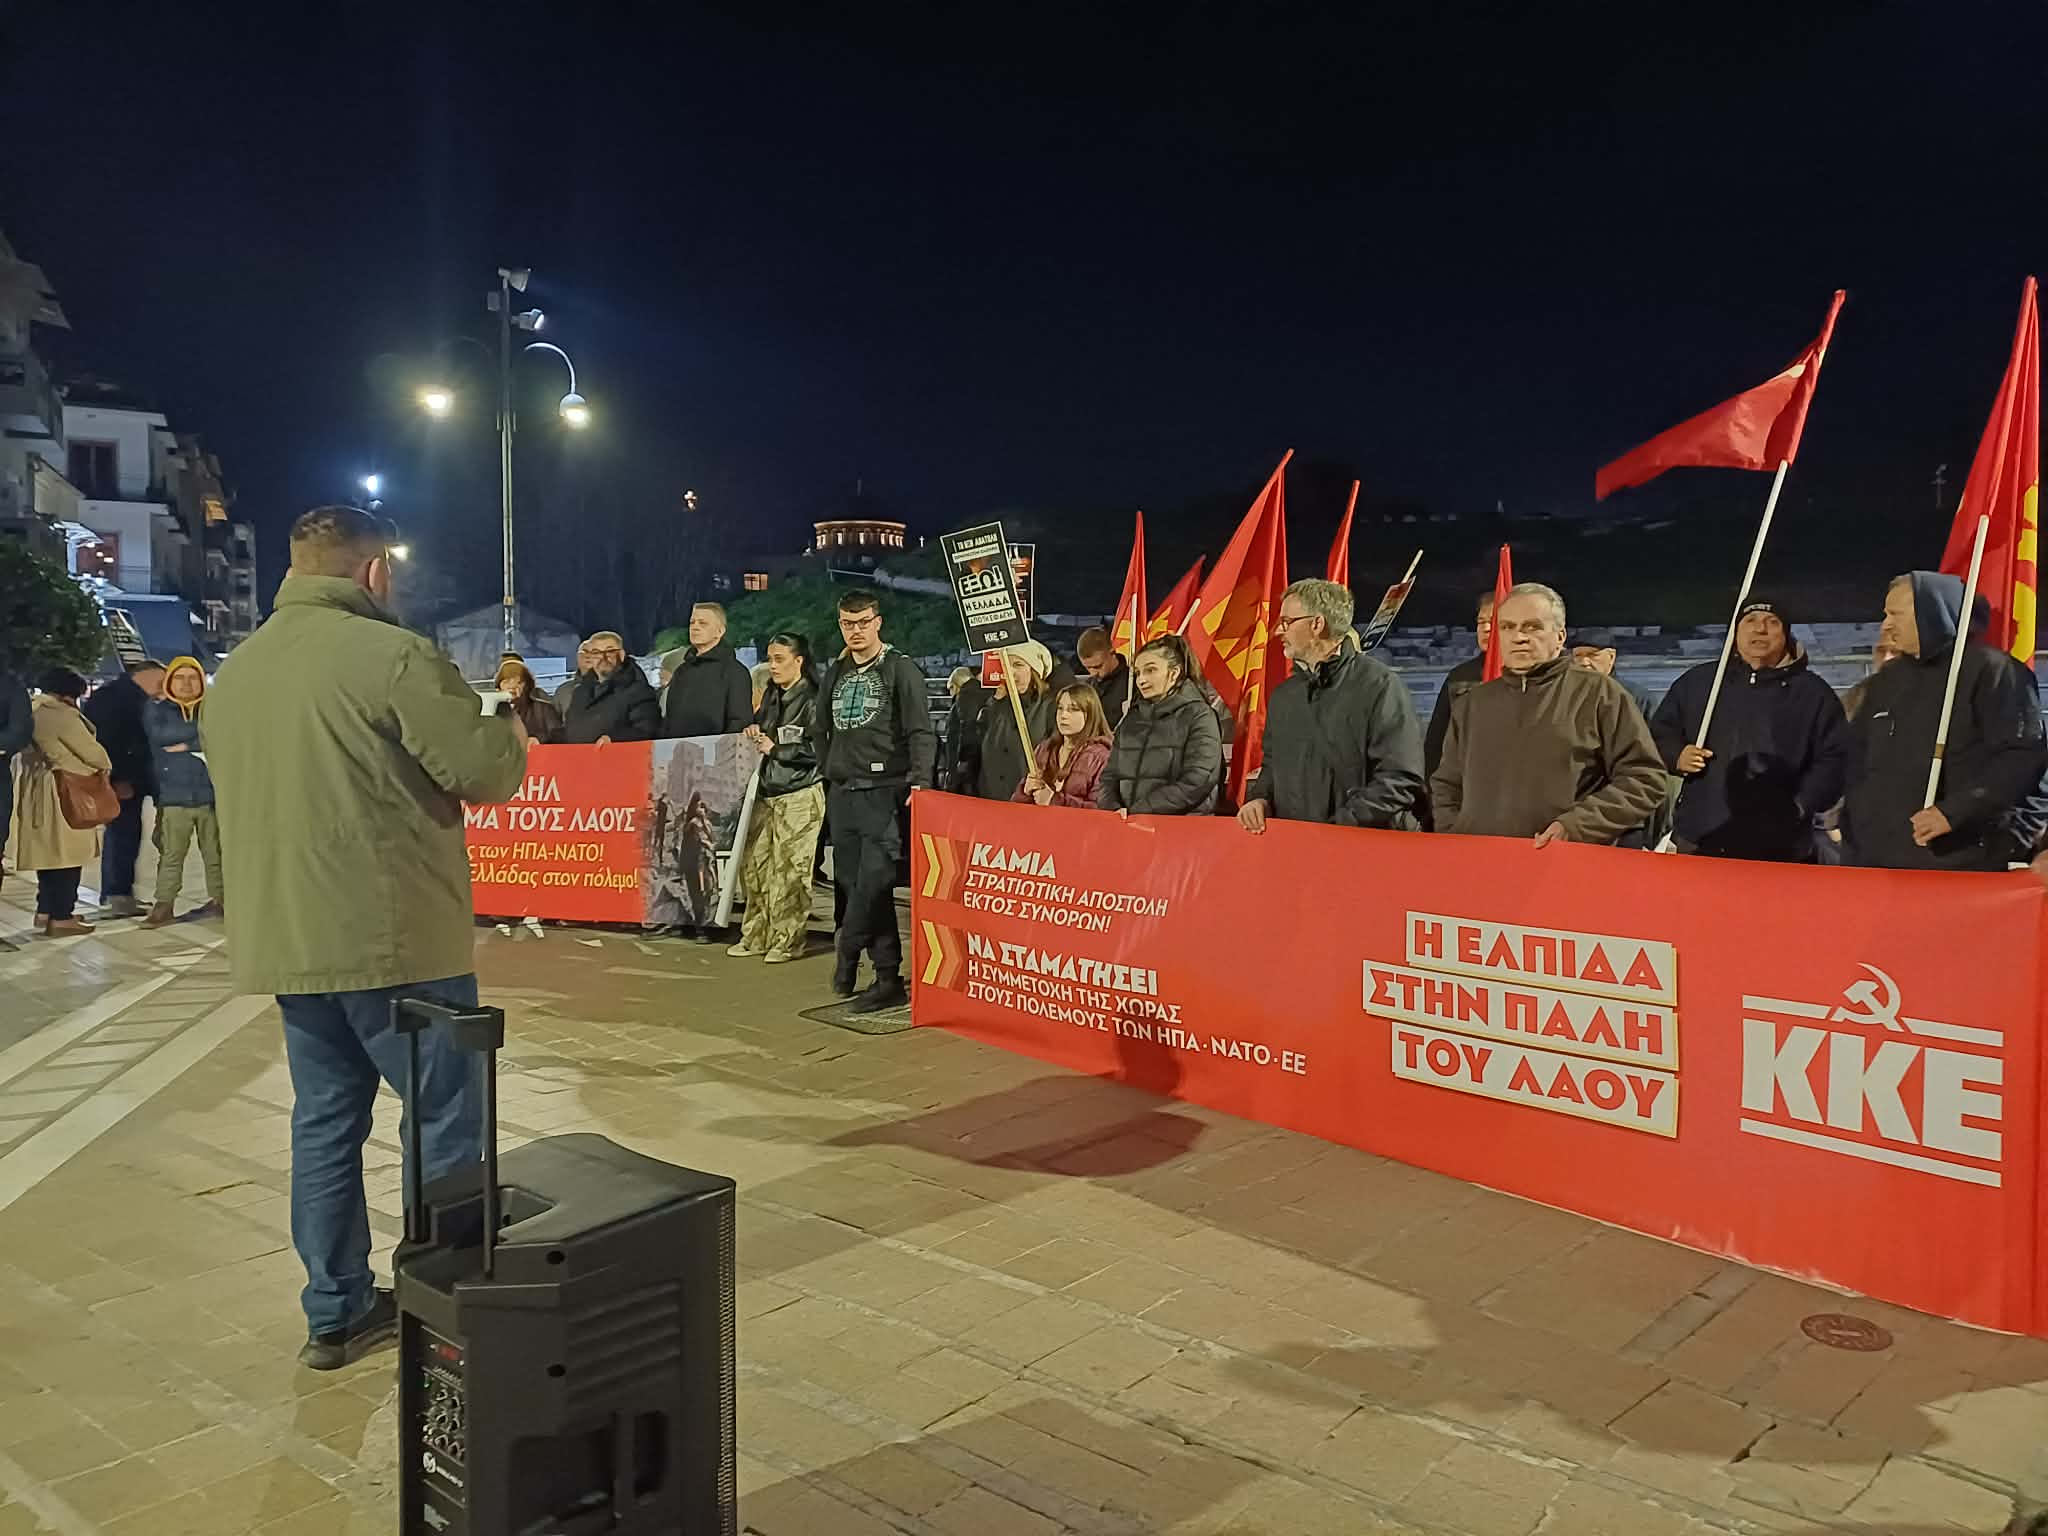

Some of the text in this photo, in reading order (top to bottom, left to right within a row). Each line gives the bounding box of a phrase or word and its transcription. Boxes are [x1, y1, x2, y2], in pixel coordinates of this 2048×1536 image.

[960, 565, 1004, 596] ΕΞΩ!
[973, 594, 1009, 611] ΕΛΛΑΔΑ
[510, 775, 561, 802] ΑΗΛ
[463, 805, 636, 832] ΜΑ ΤΟΥΣ ΛΑΟΥΣ
[479, 845, 510, 859] των
[971, 843, 1057, 879] ΚΑΜΙΑ
[542, 871, 581, 887] στον
[583, 866, 639, 894] πόλεμο!
[965, 870, 1169, 917] ΣΤΡΑΤΙΩΤΙΚΗ ΑΠΟΣΤΟΛΗ
[963, 891, 1112, 934] ΕΚΤΟΣ ΣΥΝΟΡΩΝ!
[967, 931, 1158, 996] ΝΑ ΣΤΑΜΑΤΗΣΕΙ
[1413, 919, 1664, 992] Η ΕΛΠΙΔΑ
[967, 981, 1015, 1009] ΣΤΟΥΣ
[1016, 993, 1109, 1032] ΠΟΛΕΜΟΥΣ
[1111, 1016, 1152, 1041] ΤΩΝ
[968, 959, 1183, 1024] Η ΣΥΜΜΕΤΟΧΗ ΤΗΣ ΧΩΡΑΣ
[1368, 968, 1665, 1056] ΣΤΗΝ ΠΑΛΗ
[1396, 1031, 1666, 1120] ΤΟΥ ΛΑΟΥ
[1740, 1017, 2004, 1162] ΚΚΕ
